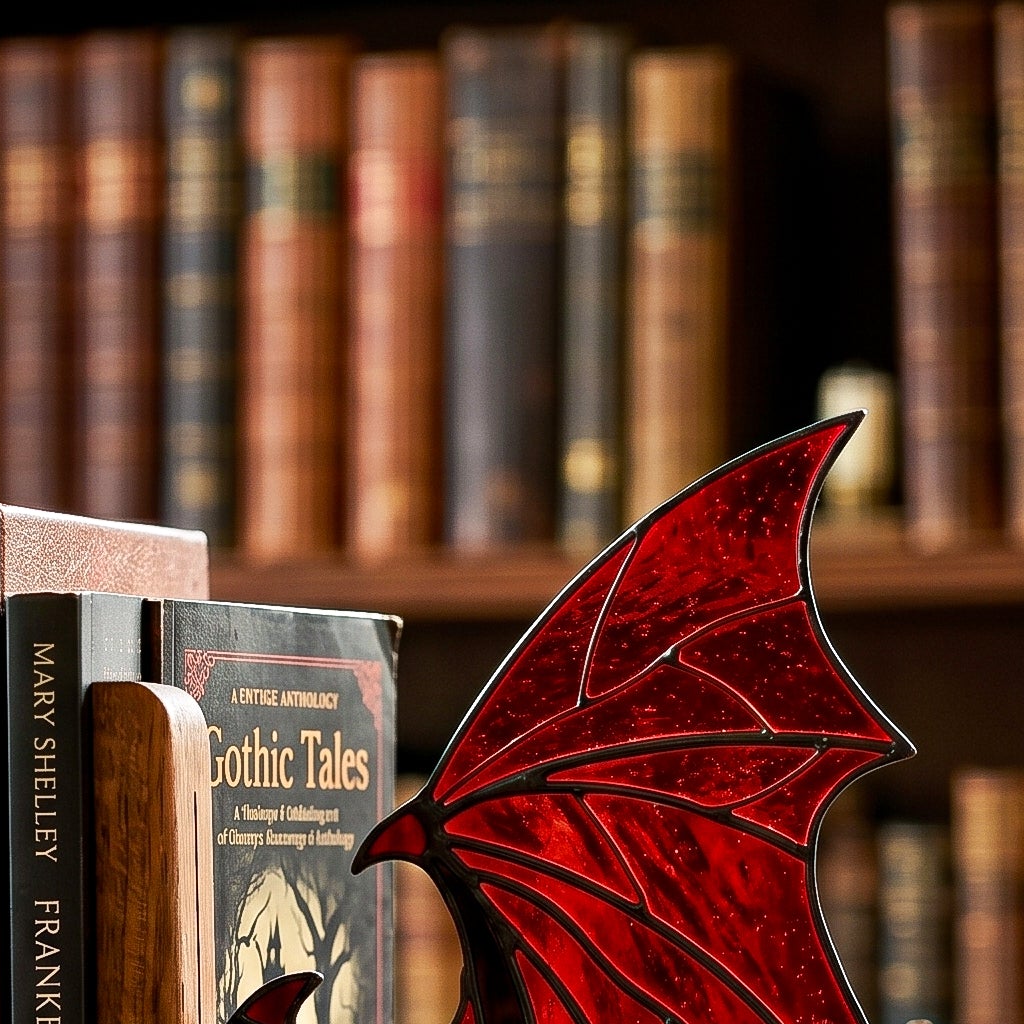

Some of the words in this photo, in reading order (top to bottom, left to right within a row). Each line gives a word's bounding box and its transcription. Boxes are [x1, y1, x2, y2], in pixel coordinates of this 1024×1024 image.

[33, 643, 55, 727] MARY
[231, 688, 238, 704] A
[280, 690, 339, 710] ANTHOLOGY
[207, 725, 294, 789] Gothic
[300, 729, 370, 791] Tales
[34, 737, 57, 863] SHELLEY
